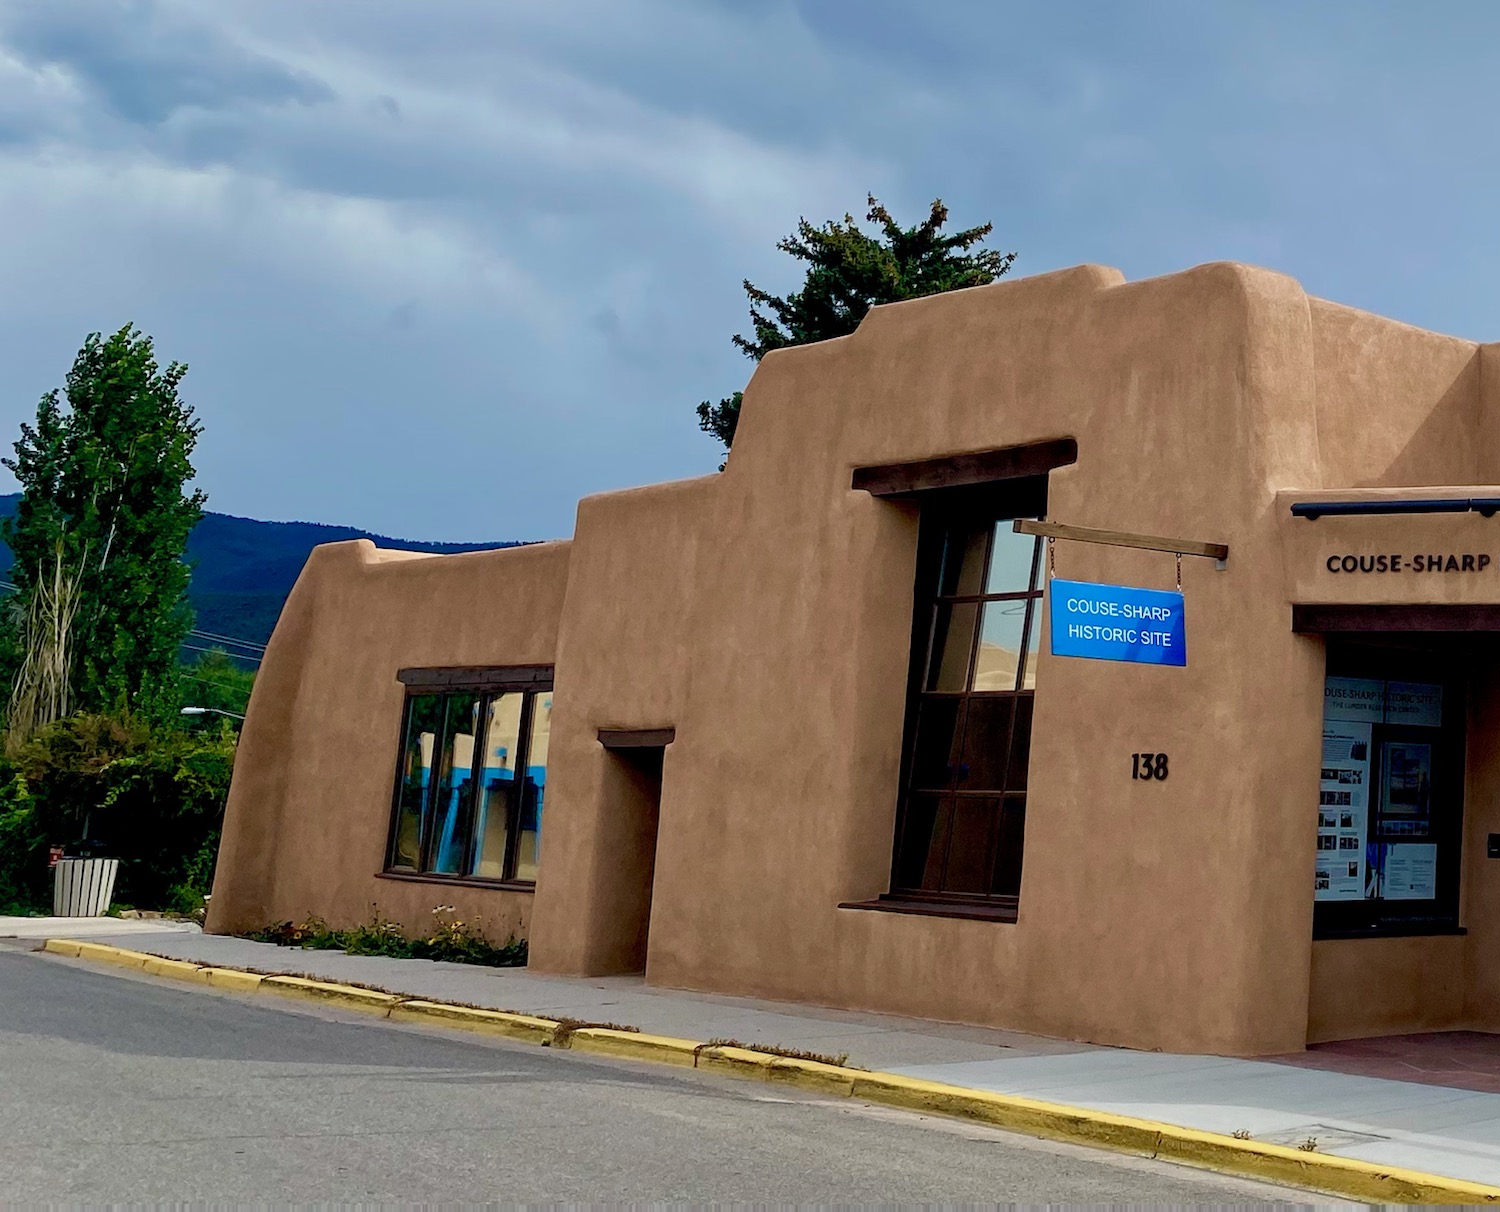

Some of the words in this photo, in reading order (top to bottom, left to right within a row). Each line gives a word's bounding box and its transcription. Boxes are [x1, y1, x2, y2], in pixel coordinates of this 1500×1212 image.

[1326, 554, 1490, 573] COUSE-SHARP
[1067, 598, 1171, 621] COUSE-SHARP
[1068, 624, 1137, 644] HISTORIC
[1140, 632, 1171, 647] SITE
[1324, 687, 1376, 700] OUSE-SHARP
[1131, 753, 1169, 781] 138
